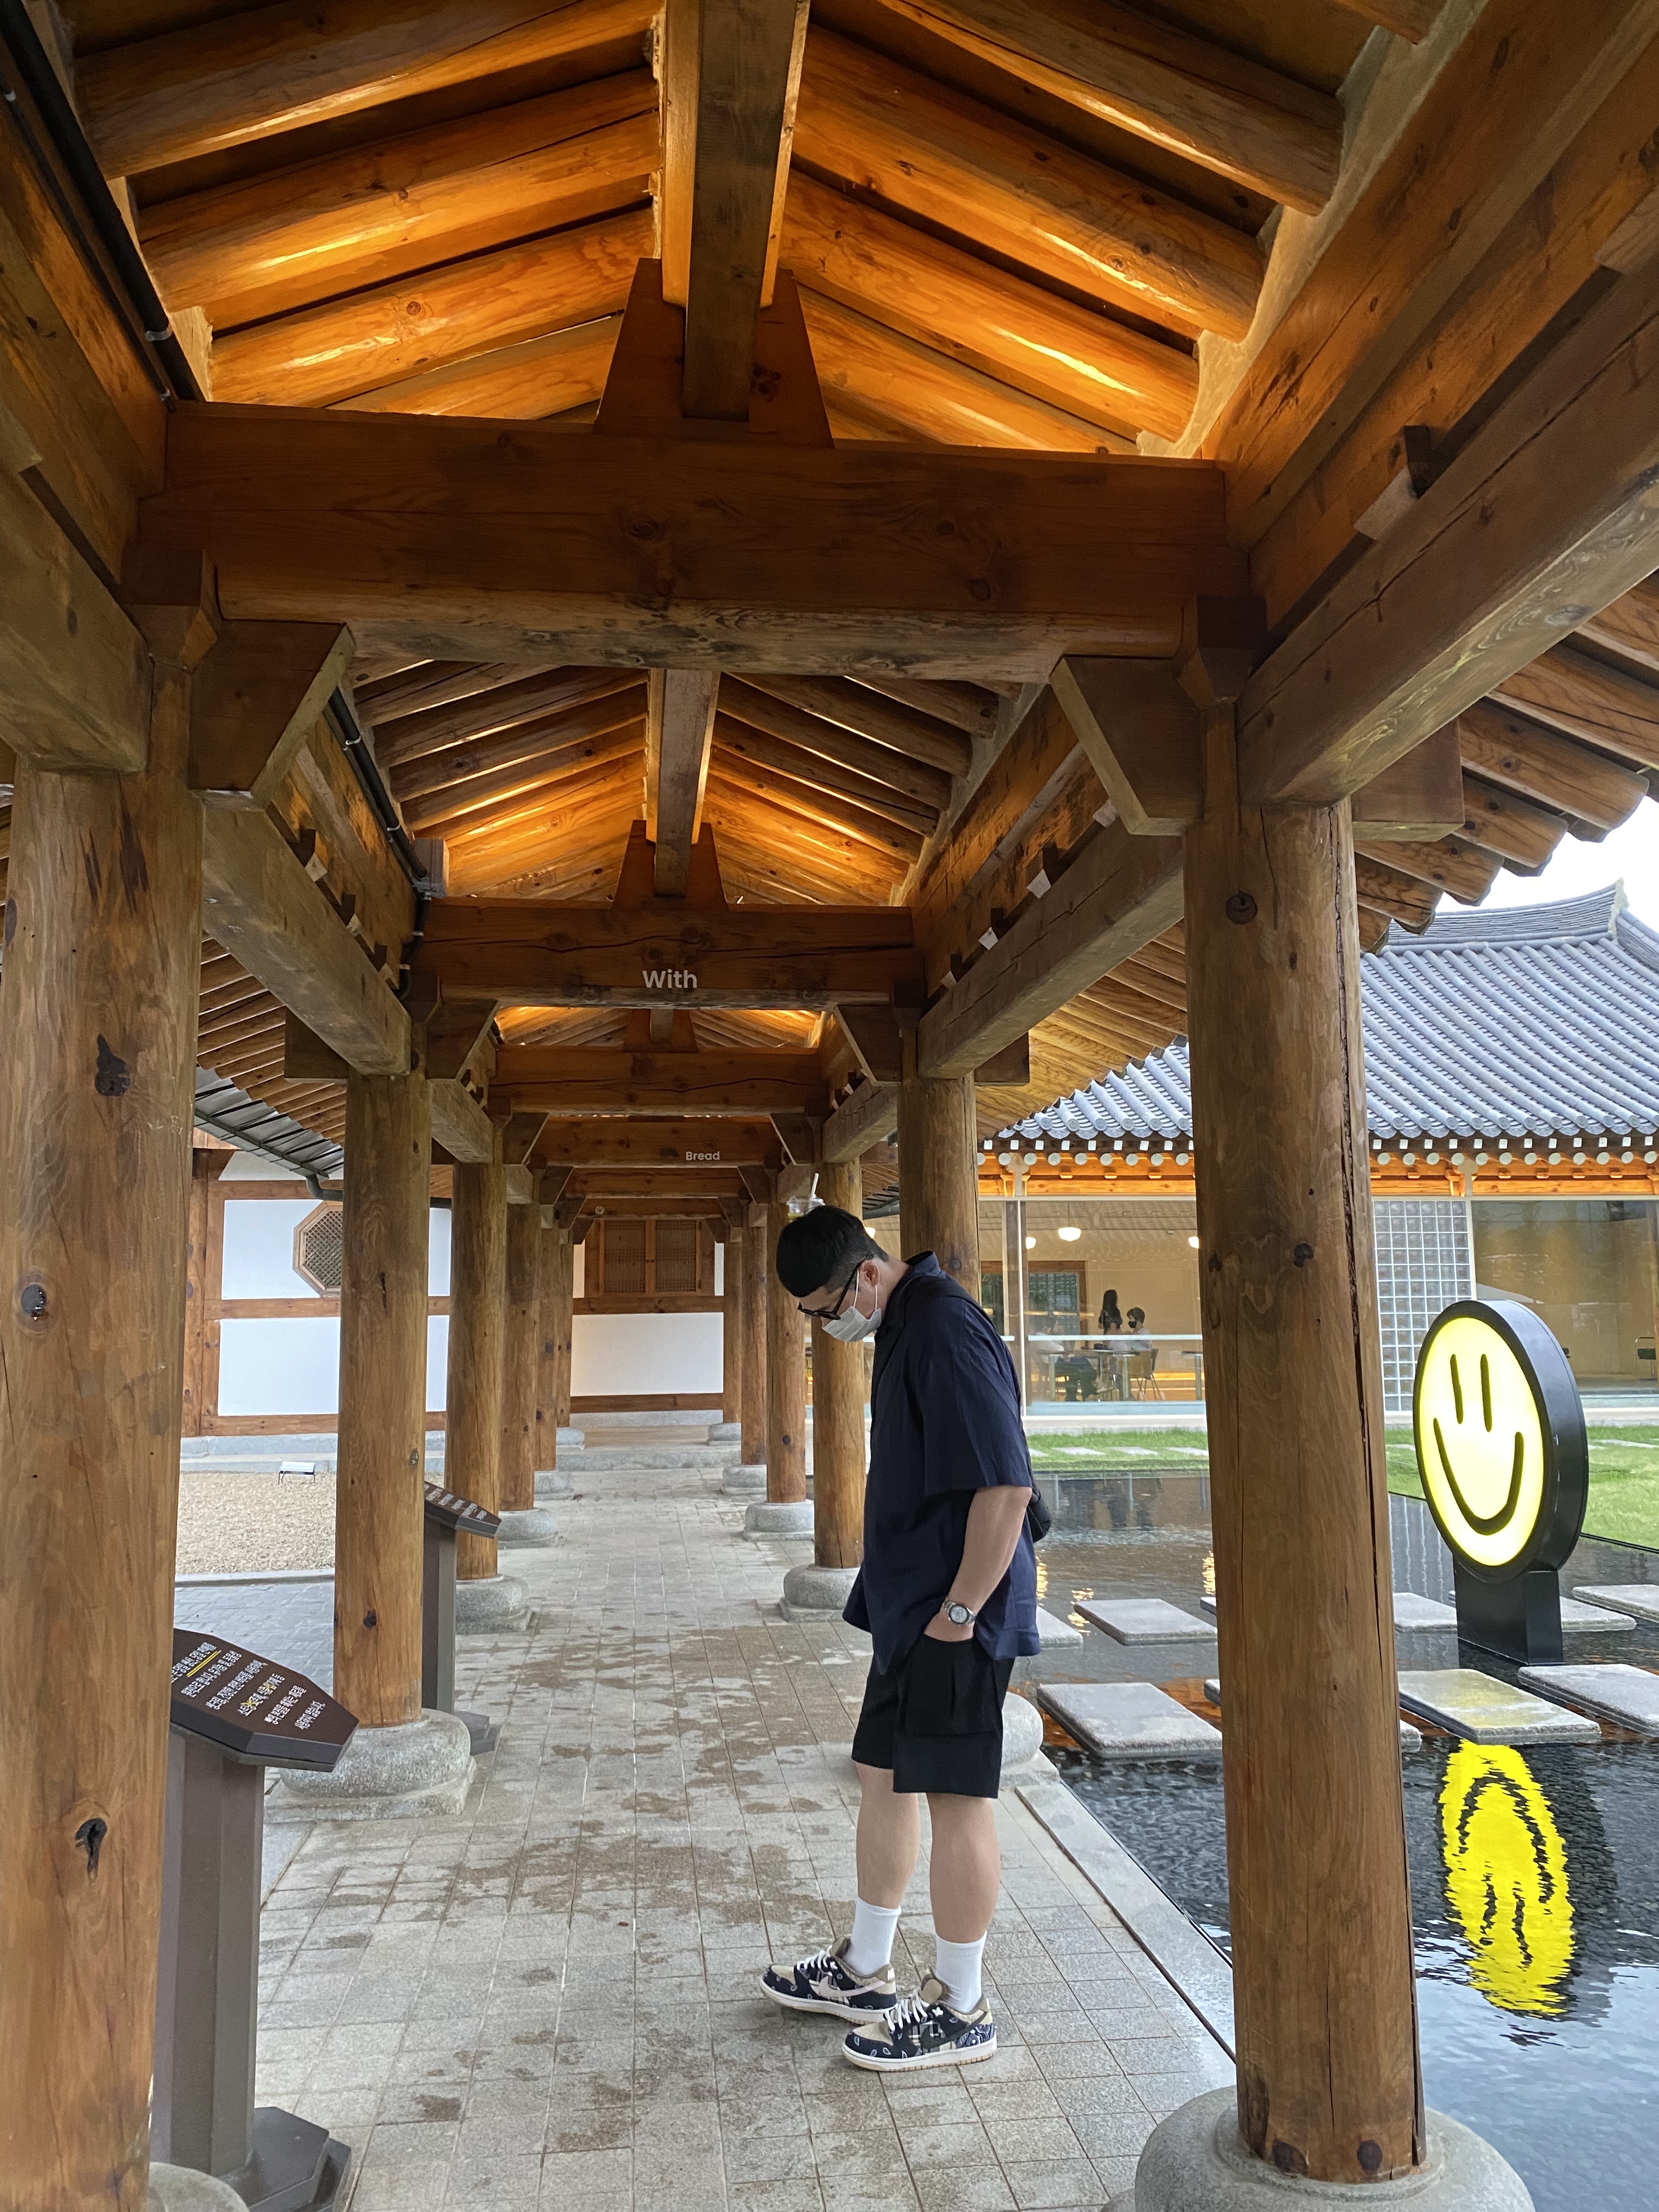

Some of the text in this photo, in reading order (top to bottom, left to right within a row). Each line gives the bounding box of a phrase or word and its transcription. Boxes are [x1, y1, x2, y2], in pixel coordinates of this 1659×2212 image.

[642, 969, 697, 988] With
[686, 1151, 720, 1160] Bread
[222, 1650, 242, 1662] 동물성
[295, 1713, 315, 1729] 사용하지
